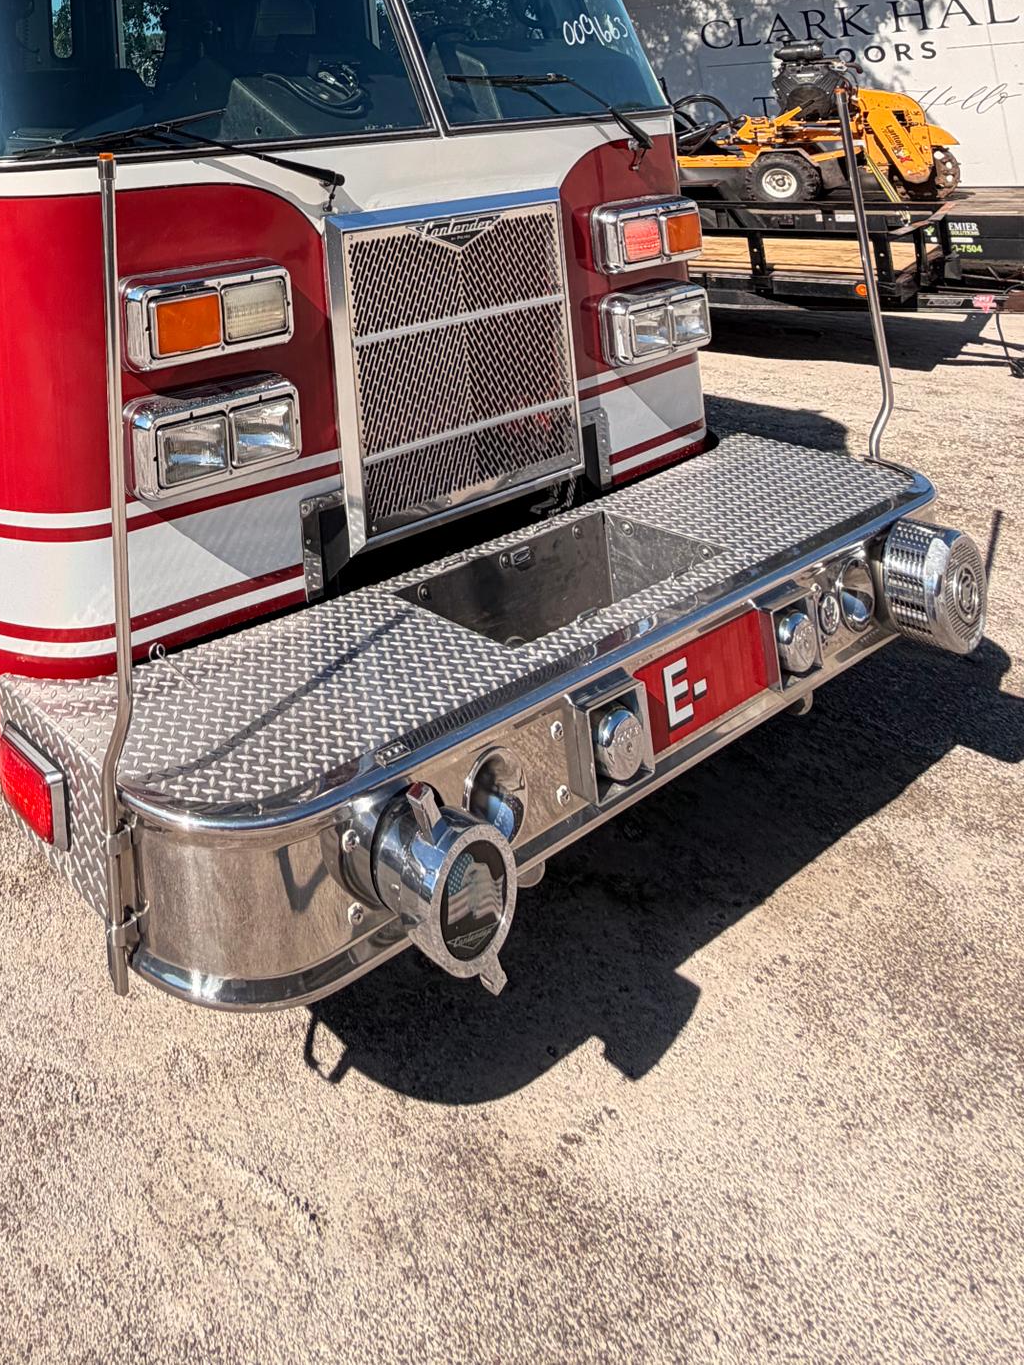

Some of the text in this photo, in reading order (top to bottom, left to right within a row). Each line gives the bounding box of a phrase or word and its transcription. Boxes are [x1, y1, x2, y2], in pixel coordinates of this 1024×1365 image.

[701, 3, 876, 50] CLARK
[835, 40, 937, 64] OORS
[905, 83, 1021, 114] Hello
[422, 217, 496, 238] Contender
[948, 222, 978, 231] EMIER
[662, 656, 707, 728] E-
